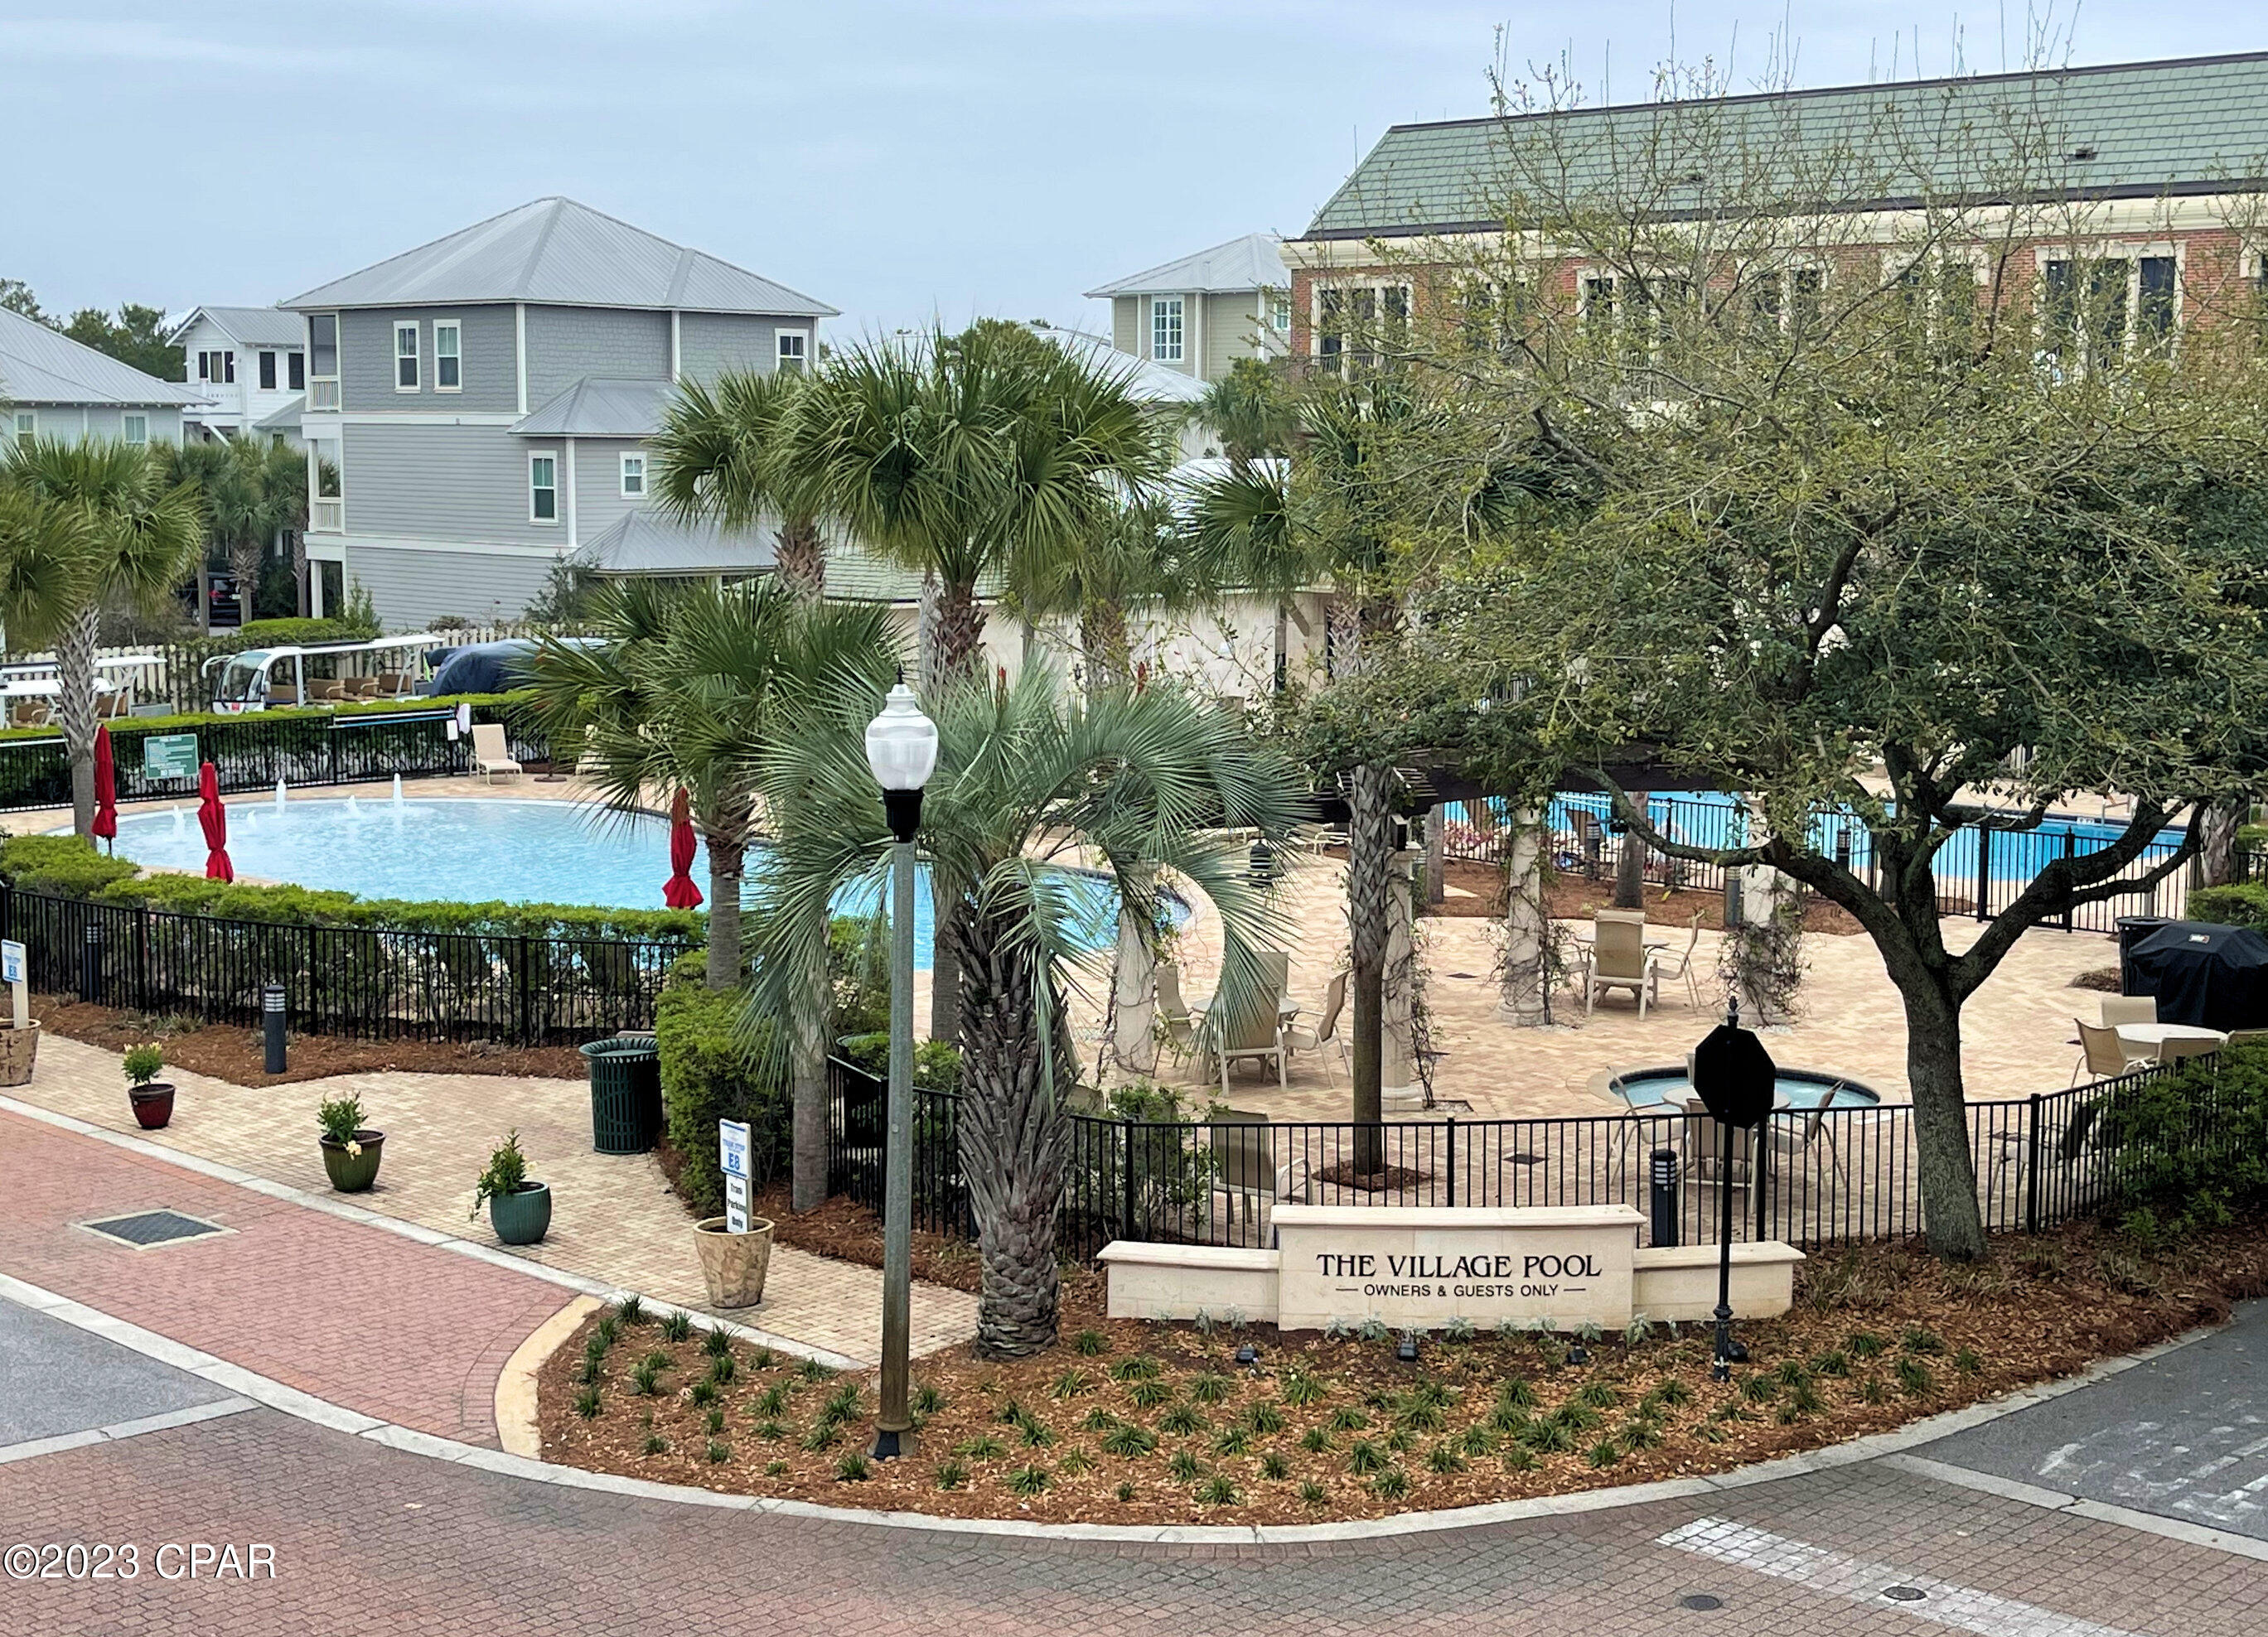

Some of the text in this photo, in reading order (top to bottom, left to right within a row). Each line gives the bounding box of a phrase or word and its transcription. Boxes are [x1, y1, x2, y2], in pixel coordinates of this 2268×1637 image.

[728, 1152, 740, 1171] E8
[1316, 1253, 1603, 1277] THE VILLAGE POOL
[1364, 1284, 1559, 1297] OWNERS & GUESTS ONLY
